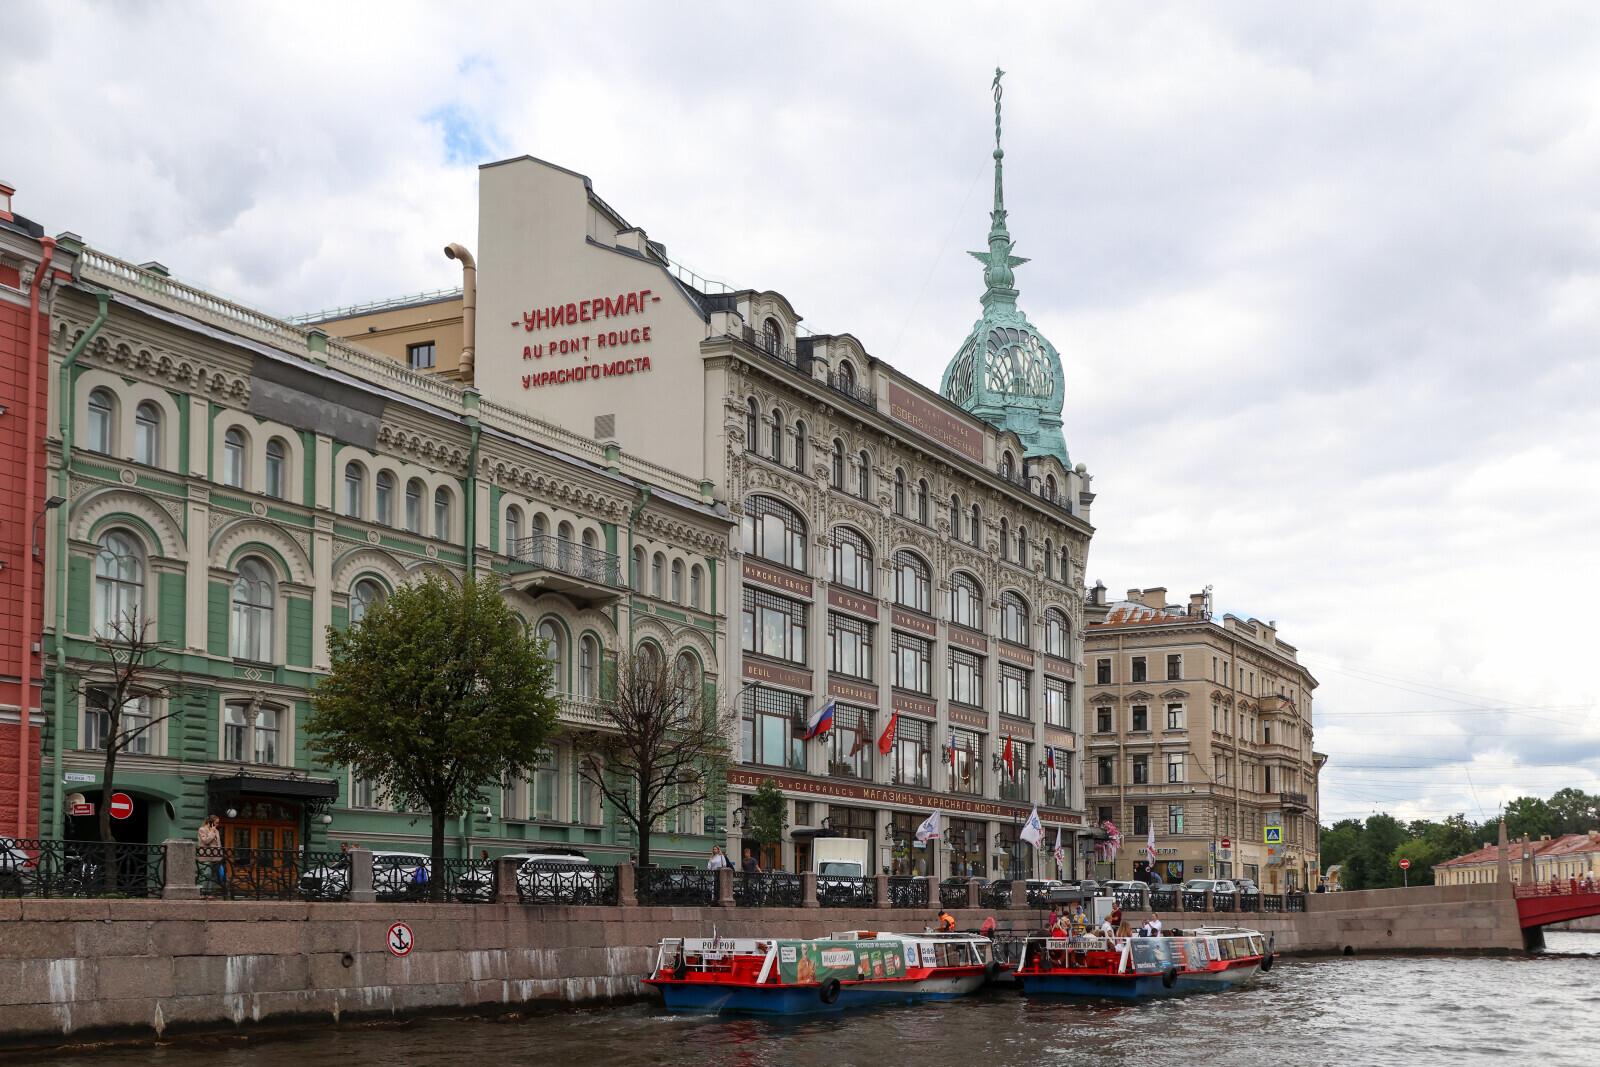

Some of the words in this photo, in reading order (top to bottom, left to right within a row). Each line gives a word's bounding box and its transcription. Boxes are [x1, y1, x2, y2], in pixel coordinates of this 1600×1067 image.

[523, 344, 543, 360] AU
[550, 336, 590, 355] PONT
[597, 326, 651, 348] ROUGE
[522, 374, 530, 389] У
[532, 364, 600, 387] КРАСНОГО
[603, 356, 651, 377] МОСТА
[731, 774, 784, 788] ЭСДЕЪ
[863, 788, 914, 804] МАГАЗИНЪ
[918, 796, 924, 805] У
[974, 803, 1001, 816] МОСТА
